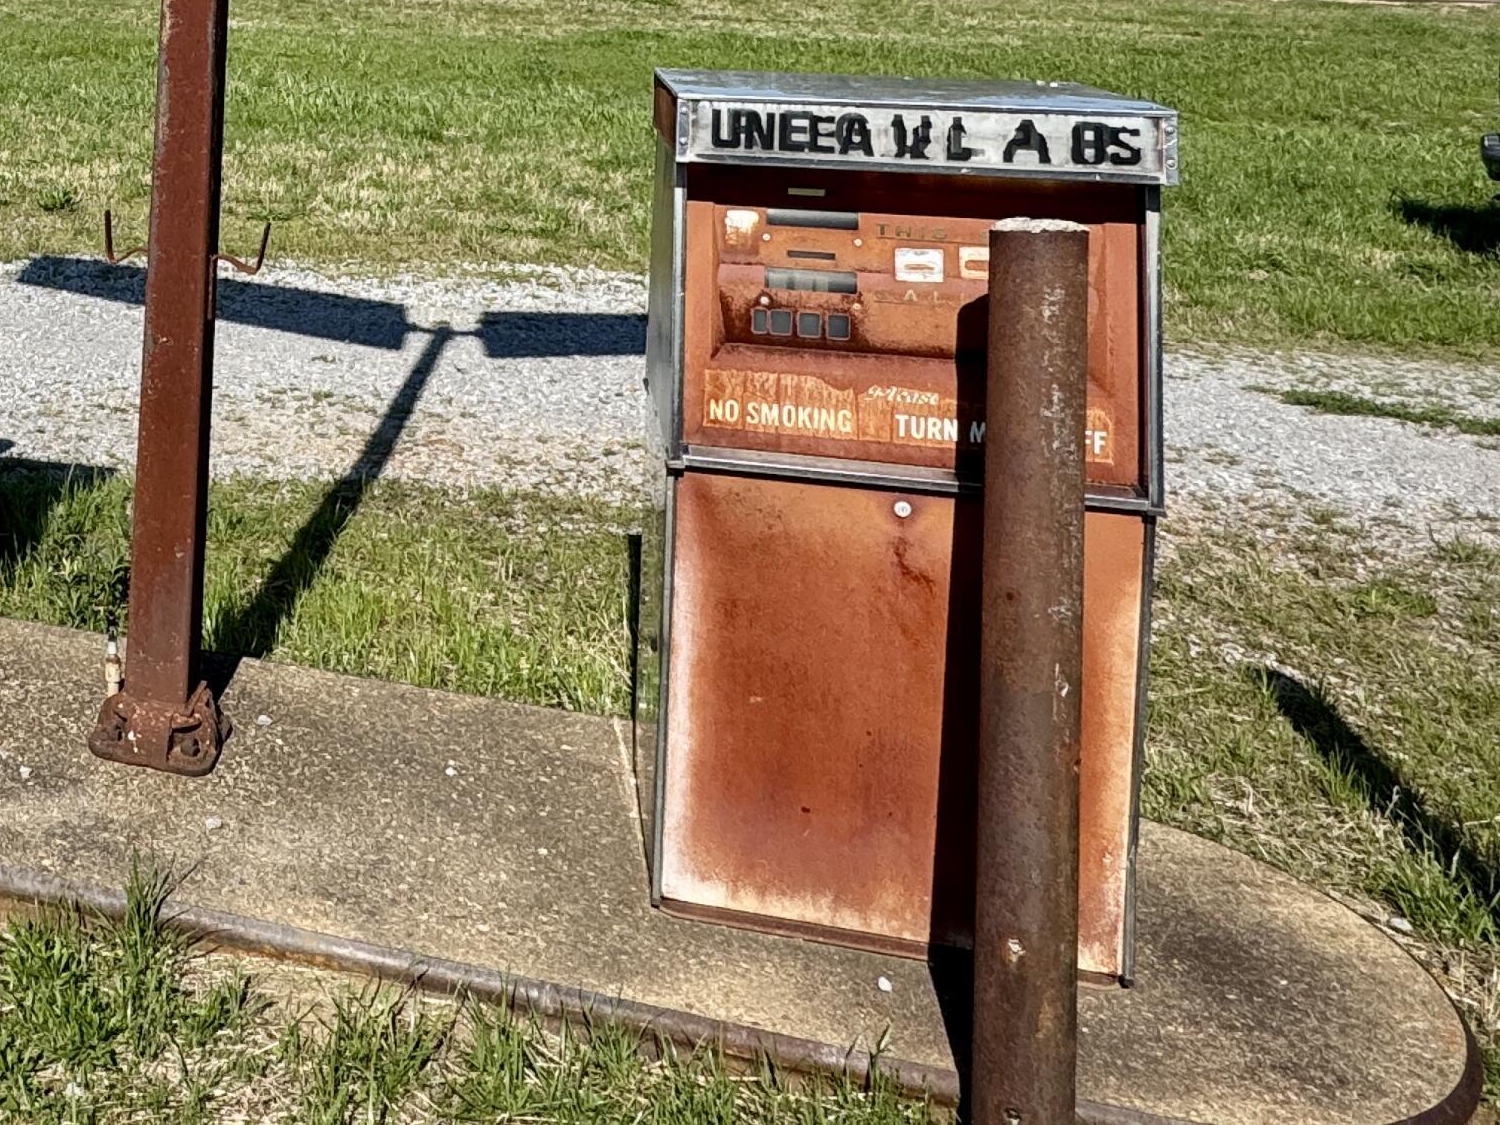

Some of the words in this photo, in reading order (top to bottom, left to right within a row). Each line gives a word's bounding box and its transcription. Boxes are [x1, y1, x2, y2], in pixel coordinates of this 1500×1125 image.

[709, 398, 740, 423] NO
[745, 401, 853, 433] SMOKING
[895, 414, 959, 442] TURN
